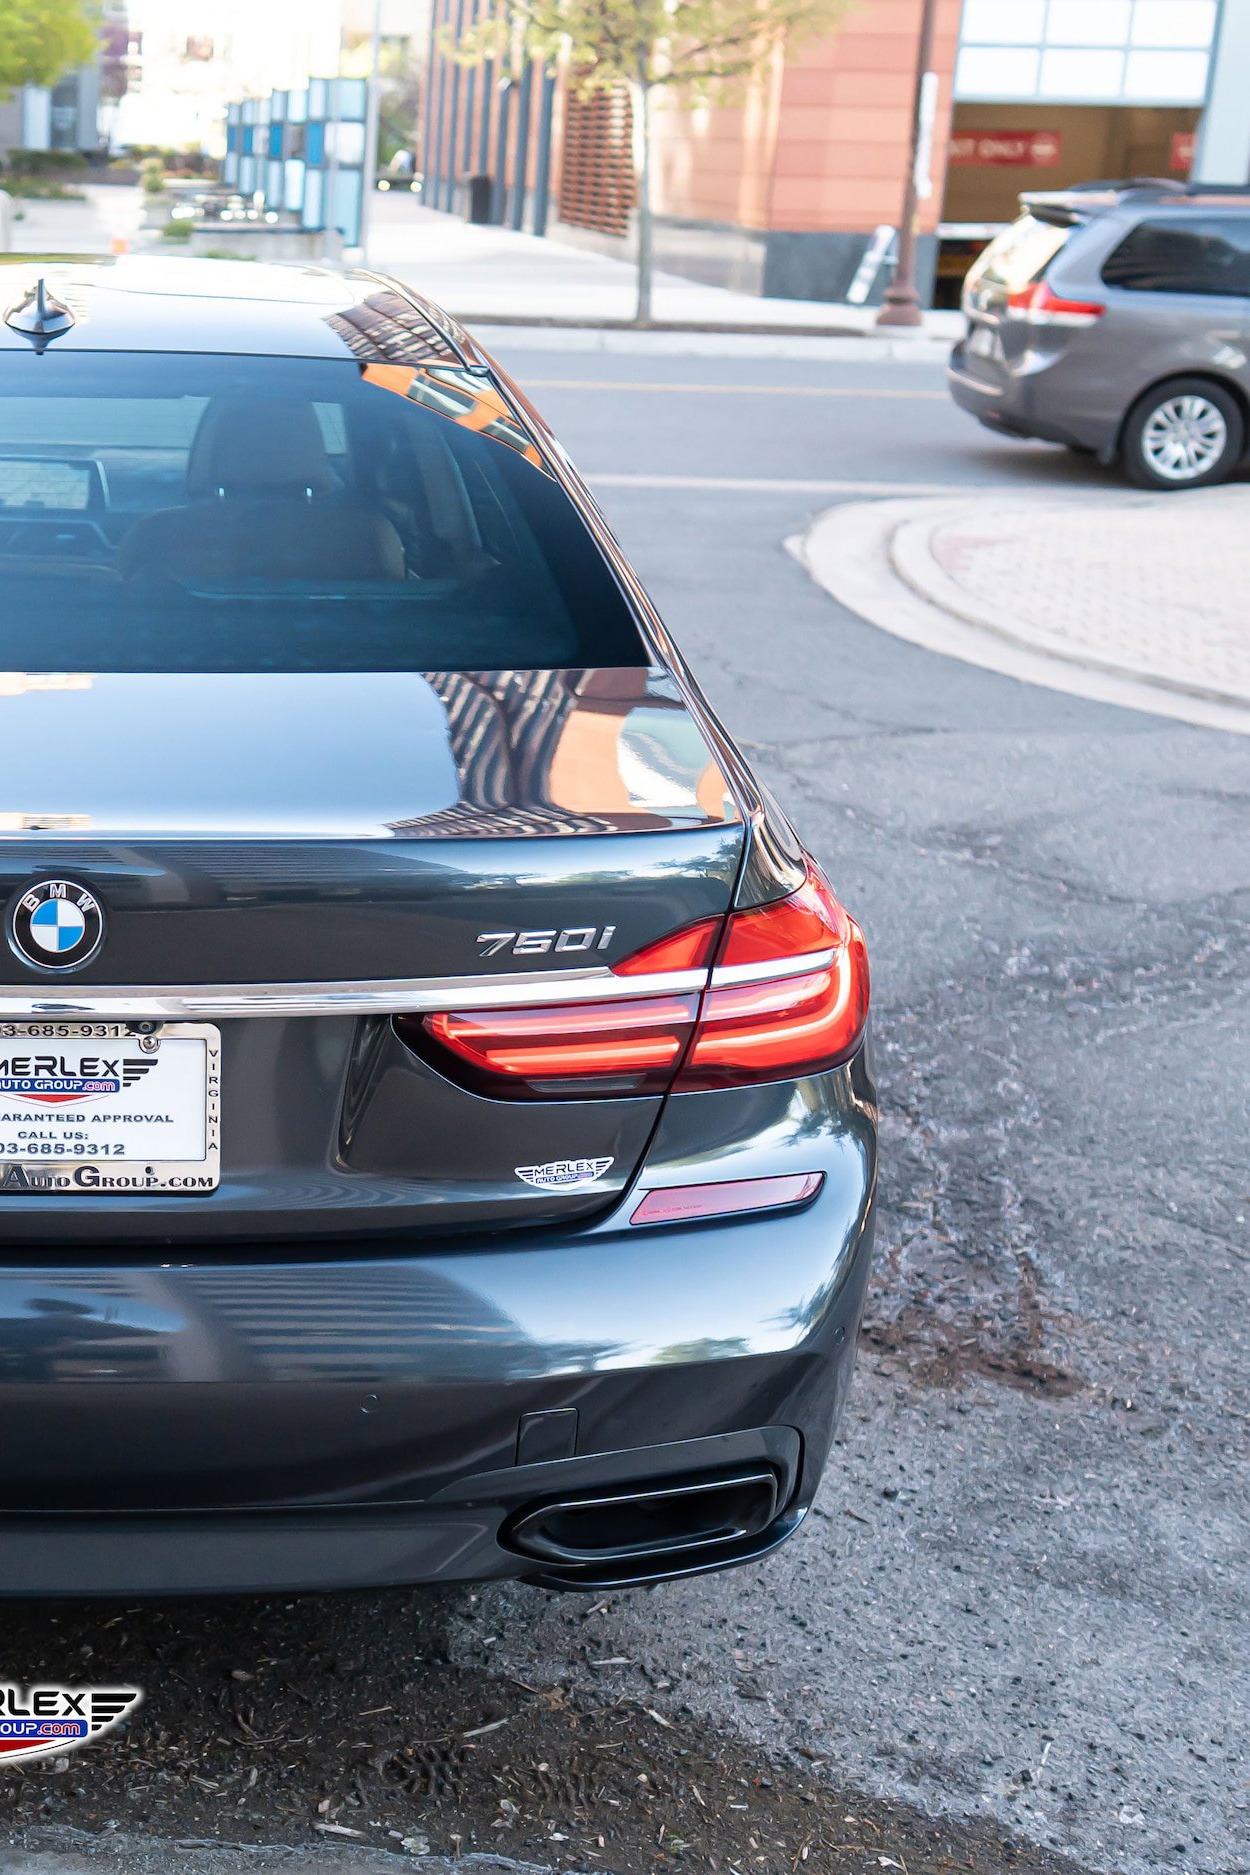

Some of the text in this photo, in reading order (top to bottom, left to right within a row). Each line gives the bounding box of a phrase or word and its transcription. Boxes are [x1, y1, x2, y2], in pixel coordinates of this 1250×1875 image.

[22, 883, 95, 912] BMW
[476, 925, 617, 957] 750i
[34, 1079, 117, 1092] GROUP.com
[208, 1050, 219, 1150] VIRGINIA
[91, 1114, 175, 1123] APPROVAL
[17, 1131, 89, 1140] CALL US:
[534, 1162, 594, 1177] MERLEX
